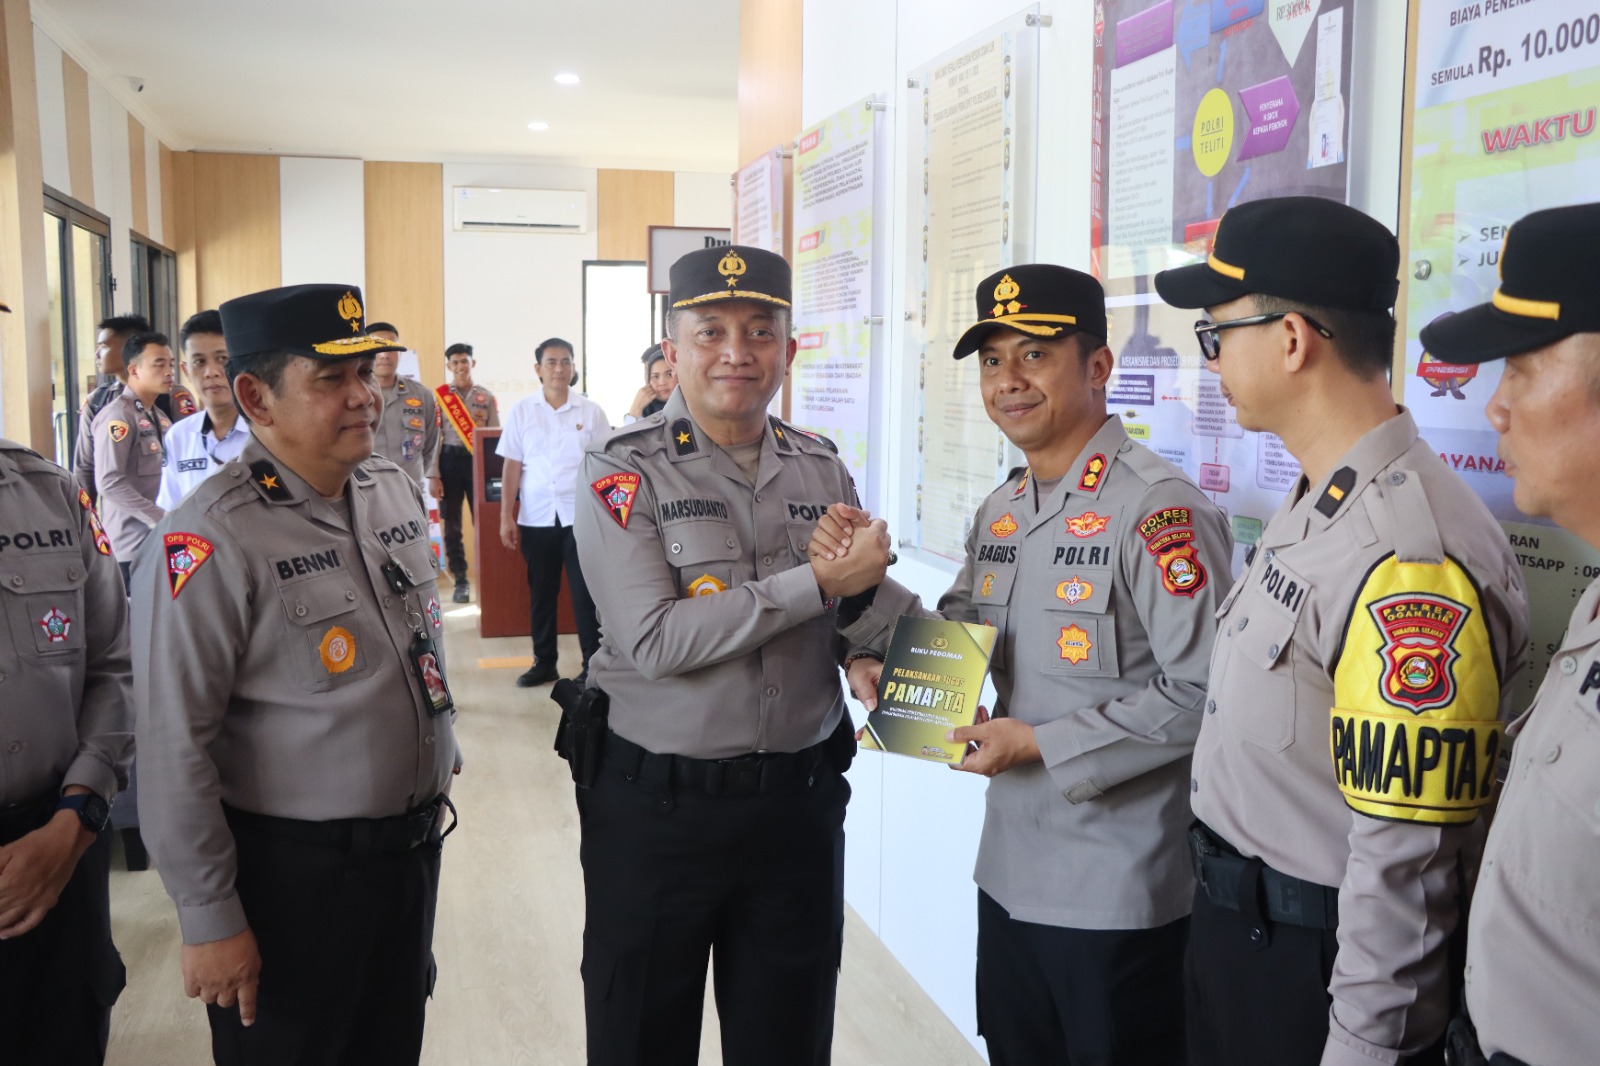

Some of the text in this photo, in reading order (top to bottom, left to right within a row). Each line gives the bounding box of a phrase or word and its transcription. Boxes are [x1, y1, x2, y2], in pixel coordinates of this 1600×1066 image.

[1450, 4, 1481, 27] BIAYA
[1431, 13, 1600, 86] SEMULA Rp. 10.000
[1201, 116, 1224, 132] POLRI
[1482, 108, 1596, 153] WAKTU
[1200, 138, 1224, 154] TELITI
[1121, 356, 1150, 366] MEKANISME
[1150, 356, 1160, 366] DAN
[450, 404, 470, 432] POLRES
[180, 460, 204, 470] DICKY
[662, 499, 728, 522] MARSUDIANTO
[1140, 510, 1188, 533] POLRES
[1145, 520, 1168, 537] OGAN
[0, 530, 72, 550] POLRI
[168, 534, 210, 551] OPS POLRI
[379, 520, 424, 548] POLRI
[978, 544, 1016, 564] BAGUS
[1053, 546, 1110, 566] POLRI
[276, 549, 340, 580] BENNI
[1260, 564, 1304, 612] POLRI
[1383, 602, 1454, 620] POLRES
[1388, 610, 1422, 622] OGAN
[911, 646, 963, 660] BUKU PEDOMAN
[893, 668, 964, 687] PELAKSANAAN TUGAS
[883, 682, 965, 713] PAMAPTA
[1332, 716, 1476, 800] PAMAPTA
